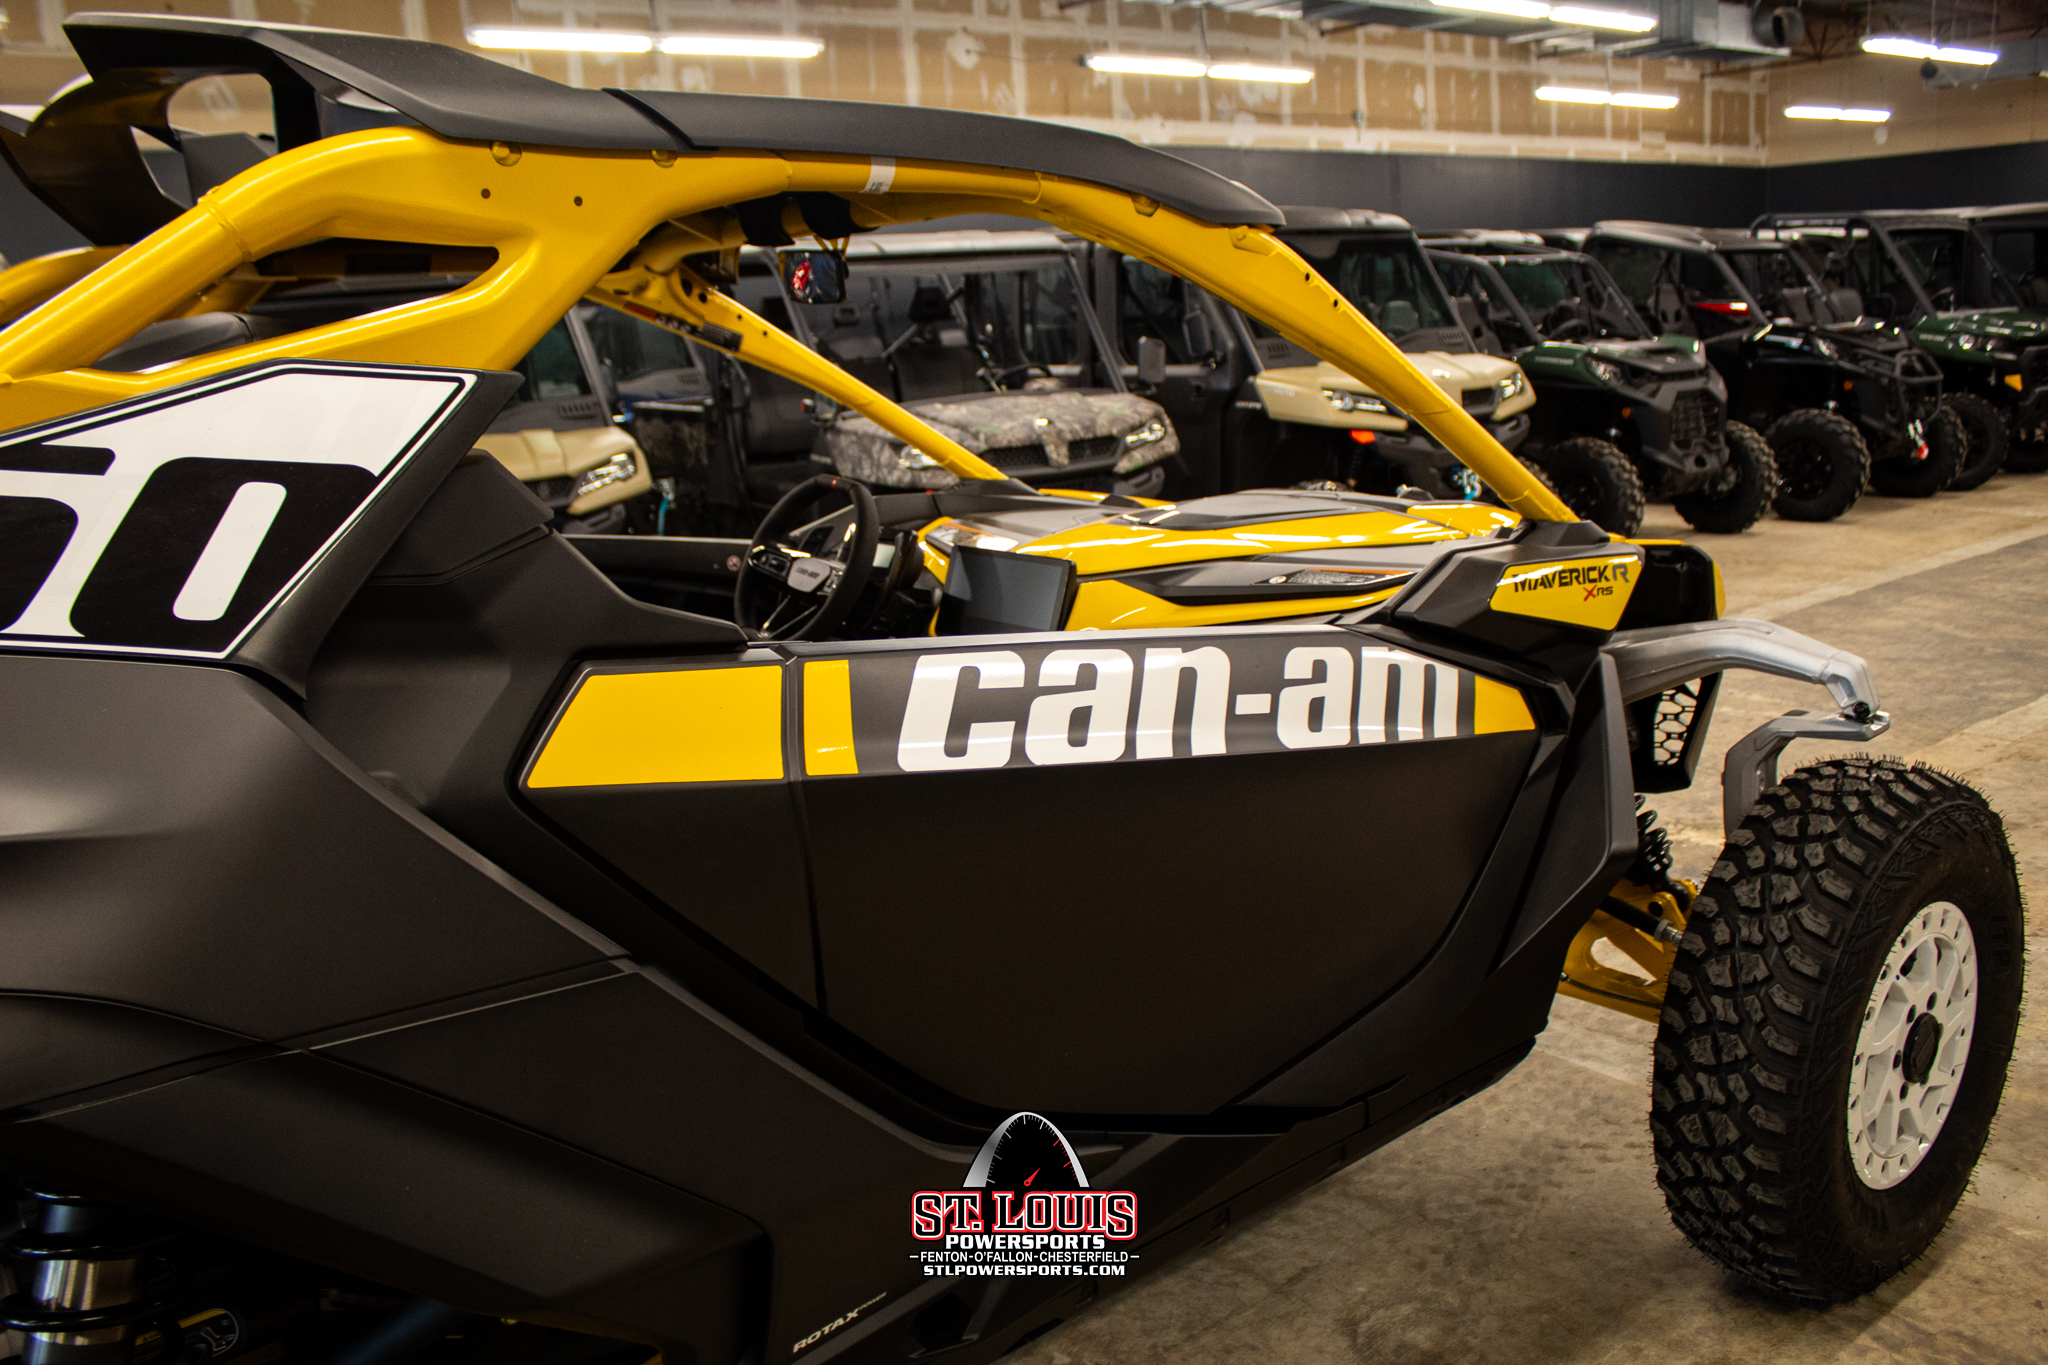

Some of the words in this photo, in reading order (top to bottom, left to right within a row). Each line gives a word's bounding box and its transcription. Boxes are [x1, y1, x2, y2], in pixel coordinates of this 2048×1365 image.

[1512, 565, 1610, 592] MAVERICK
[1612, 564, 1629, 583] R
[897, 646, 1458, 771] can-am
[793, 1307, 859, 1353] ROTAX
